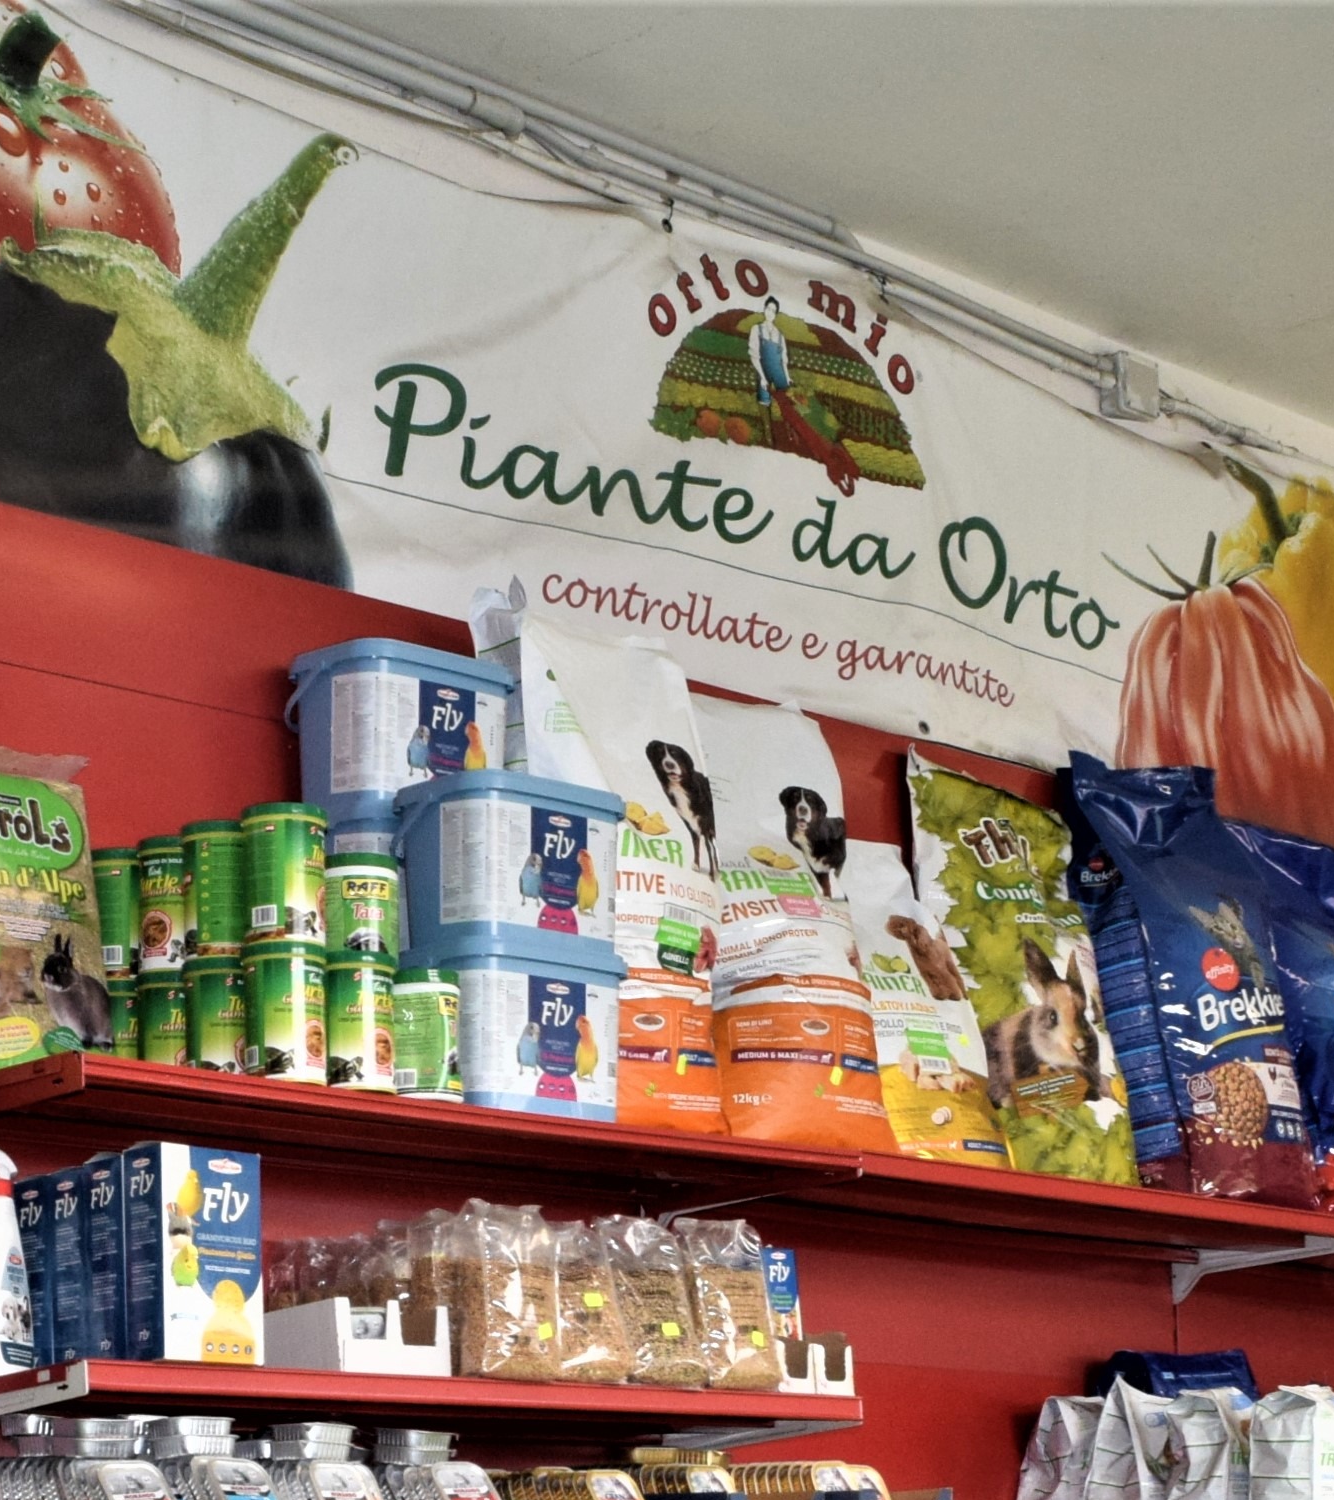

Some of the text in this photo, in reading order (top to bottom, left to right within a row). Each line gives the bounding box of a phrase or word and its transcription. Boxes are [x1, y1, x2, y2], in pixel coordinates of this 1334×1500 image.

[373, 361, 1121, 652] Piante da Orto
[540, 569, 1016, 710] controllate e garantite
[431, 702, 464, 733] Fly
[543, 828, 576, 862] Fly
[17, 866, 87, 903] d'Alpe
[346, 879, 387, 896] RAFF
[541, 997, 574, 1029] Fly
[1197, 988, 1285, 1032] Brekkie
[737, 1051, 769, 1061] MEDIUM
[778, 1051, 798, 1062] MAXI
[732, 1093, 761, 1106] 12kg
[129, 1169, 155, 1198] Fly
[202, 1181, 250, 1224] Fly
[768, 1262, 791, 1286] Fly
